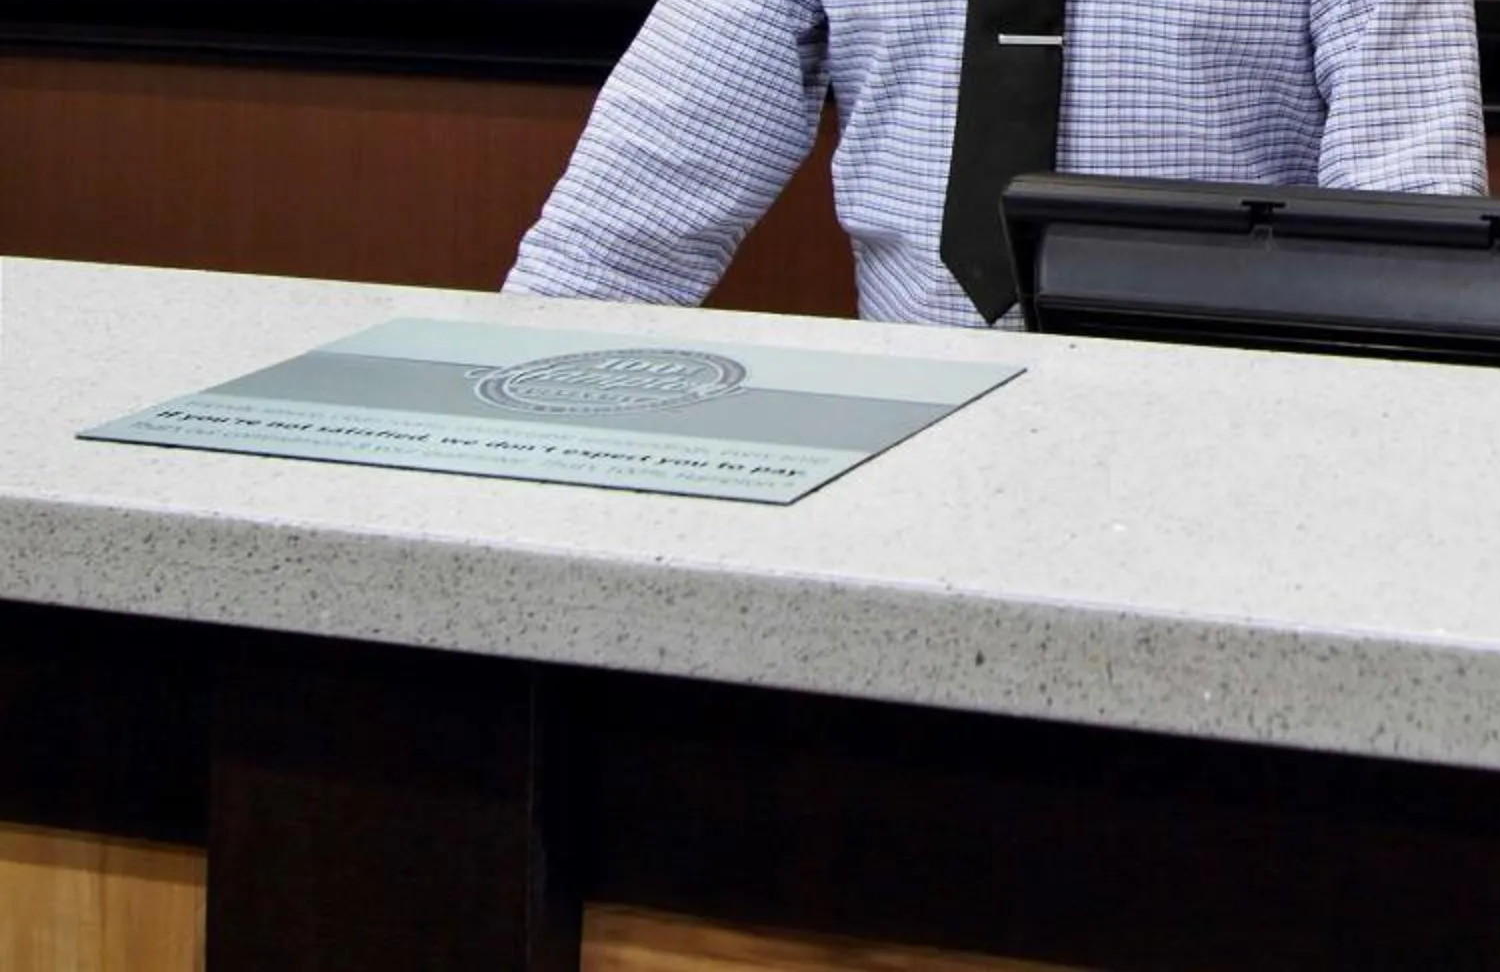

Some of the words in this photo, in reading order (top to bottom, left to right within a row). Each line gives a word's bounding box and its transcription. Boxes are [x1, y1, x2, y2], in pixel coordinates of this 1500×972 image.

[266, 420, 313, 431] not
[440, 437, 479, 446] we
[562, 449, 651, 461] expect
[654, 457, 709, 468] you
